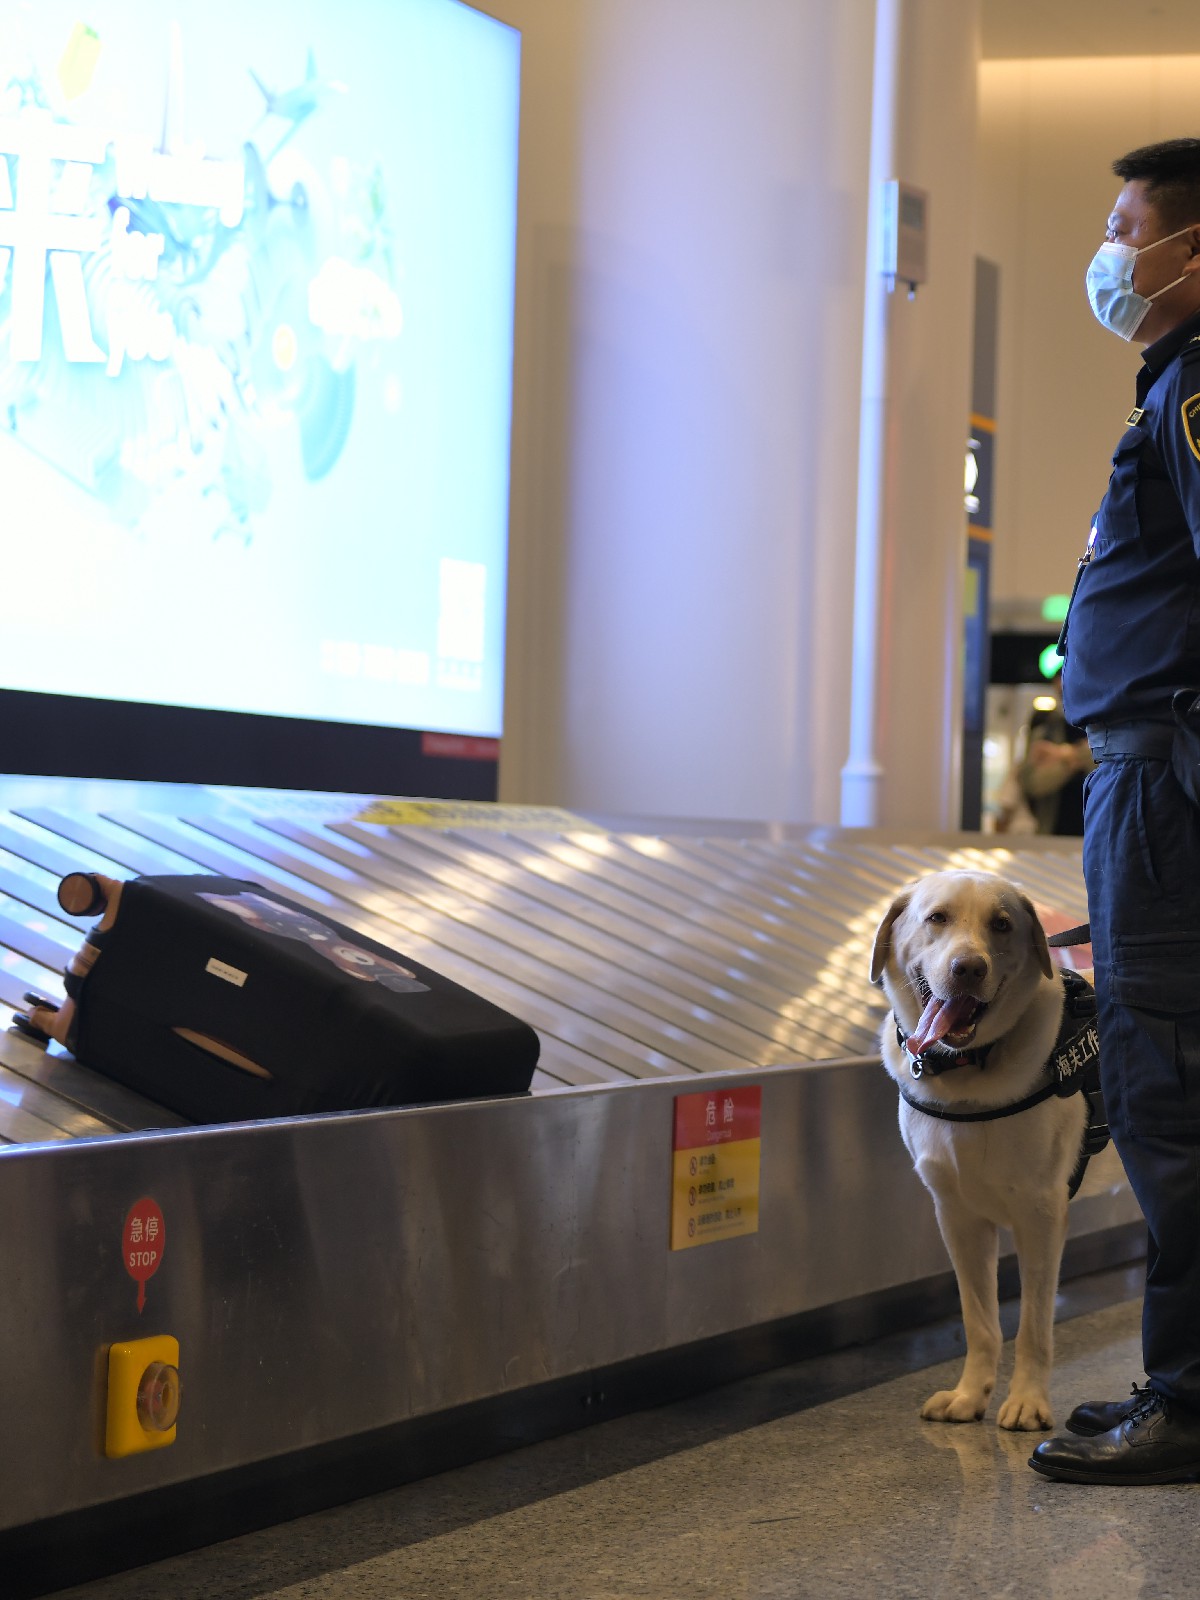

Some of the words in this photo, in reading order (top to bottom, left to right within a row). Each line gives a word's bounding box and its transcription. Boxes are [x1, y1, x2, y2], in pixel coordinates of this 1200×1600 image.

[1056, 1028, 1100, 1082] 海关工作
[130, 1216, 159, 1243] 急停
[129, 1251, 157, 1267] STOP
